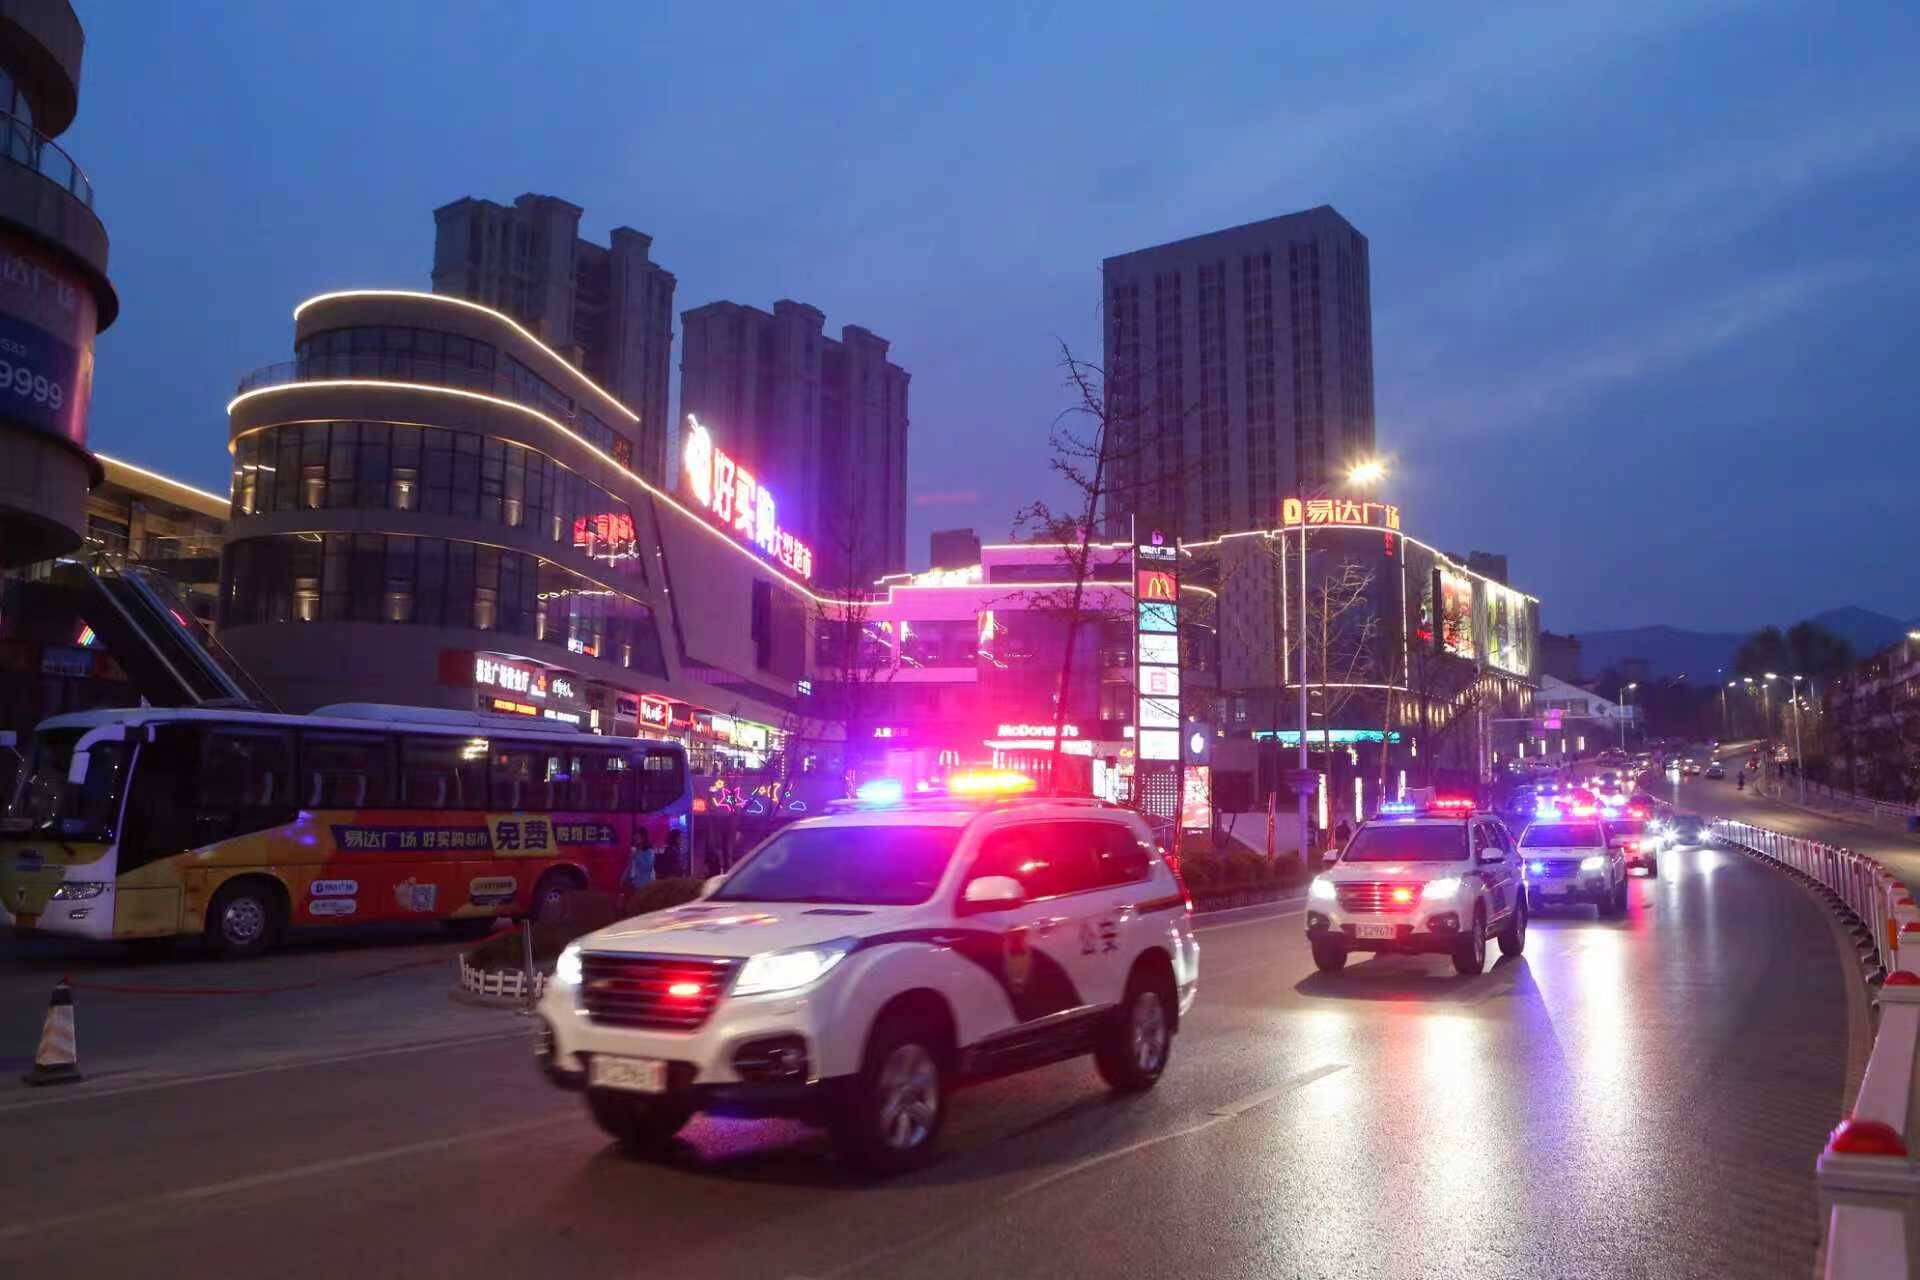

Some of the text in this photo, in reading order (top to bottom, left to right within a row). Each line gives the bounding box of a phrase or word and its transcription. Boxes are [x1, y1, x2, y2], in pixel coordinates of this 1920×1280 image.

[1307, 499, 1401, 530] 易达广场
[344, 830, 417, 848] 易达广场
[496, 819, 548, 850] 免费
